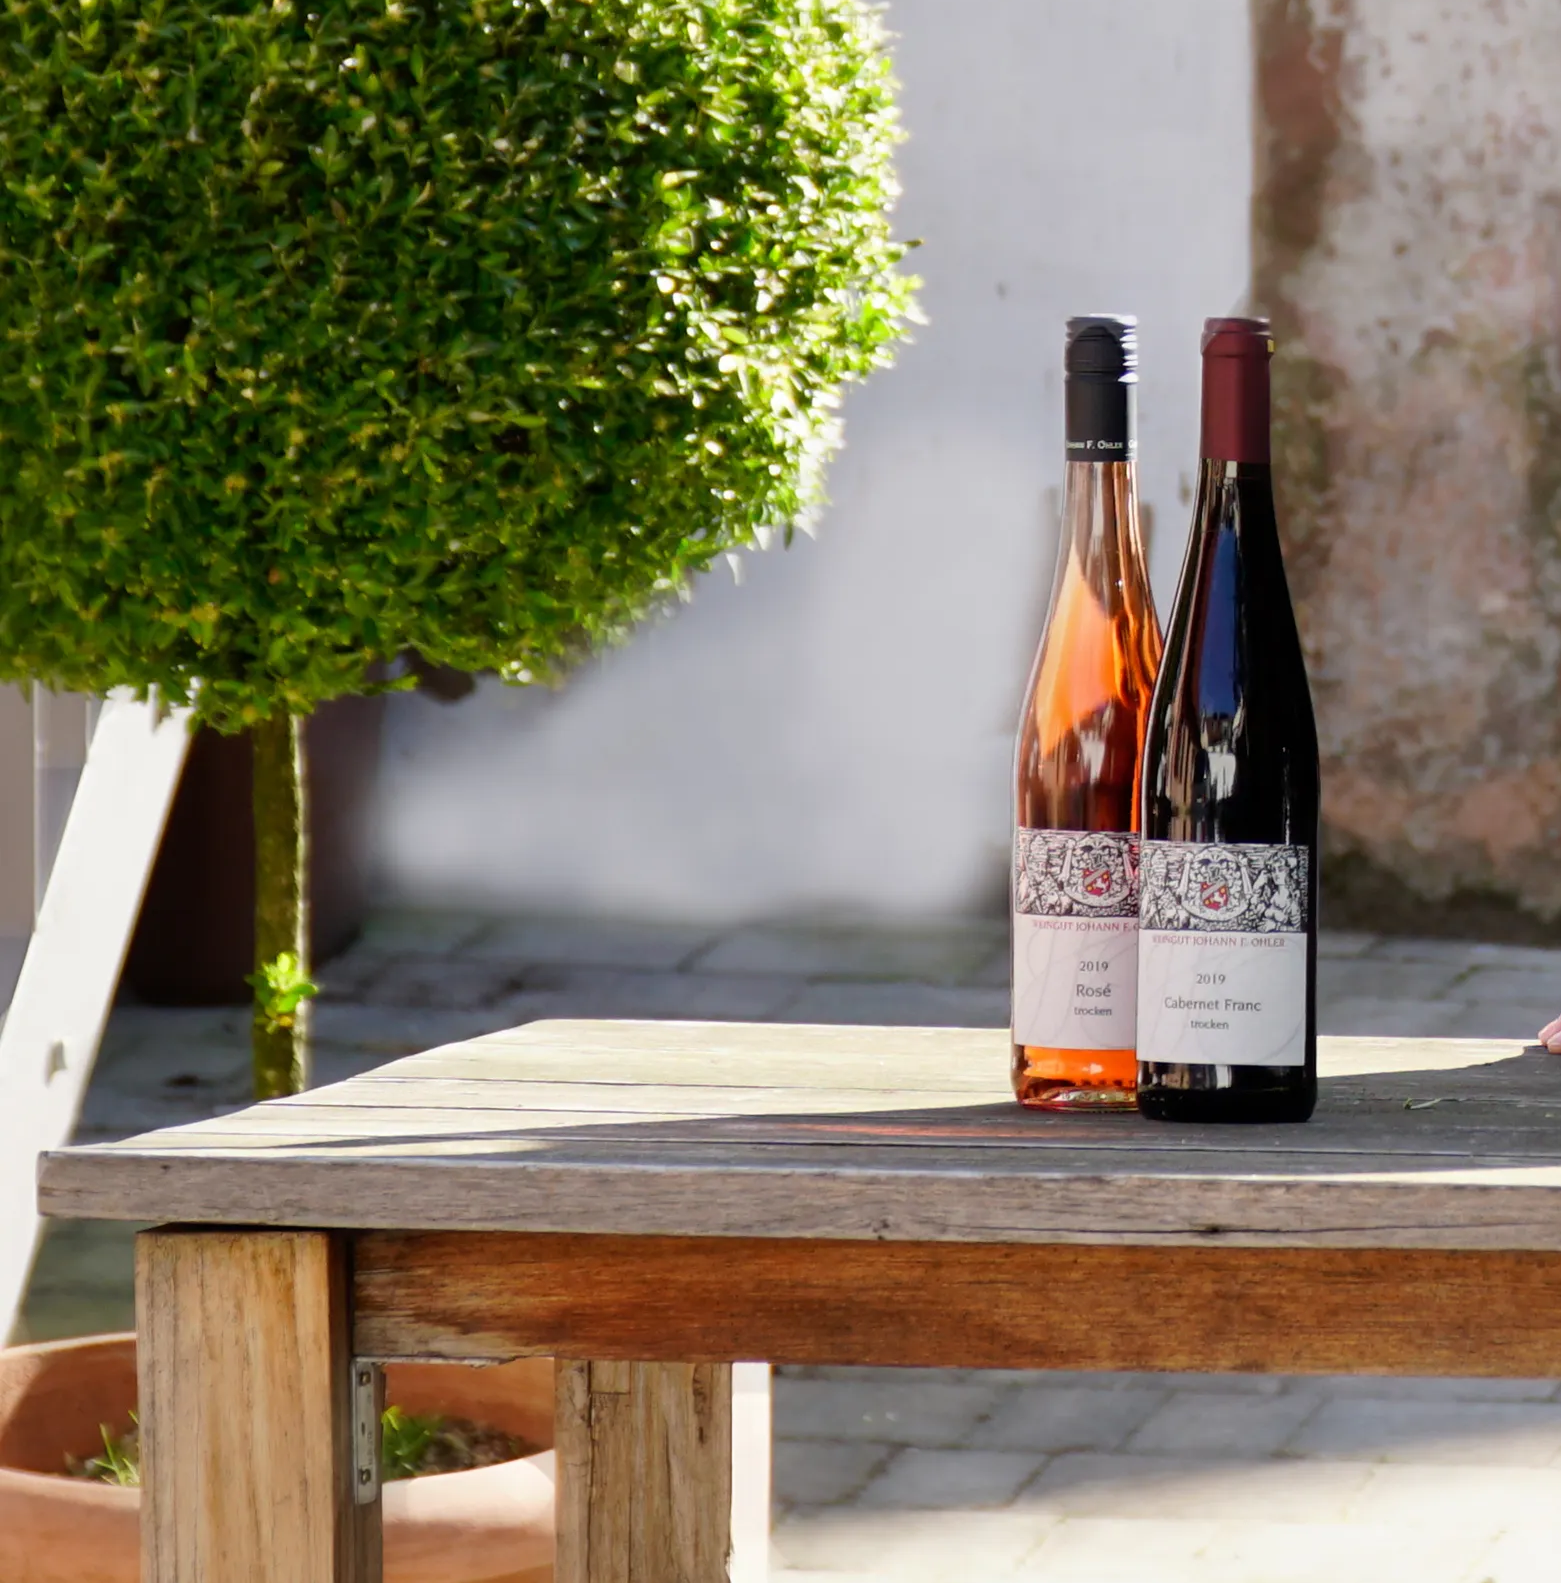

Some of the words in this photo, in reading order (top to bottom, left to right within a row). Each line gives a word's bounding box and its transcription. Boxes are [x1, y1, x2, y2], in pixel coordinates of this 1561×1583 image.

[1076, 921, 1119, 932] JOHANN
[1123, 923, 1132, 933] F.
[1193, 936, 1237, 946] JOHANN
[1250, 937, 1286, 948] OHLER
[1079, 960, 1109, 972] 2019
[1196, 973, 1227, 985] 2019
[1076, 982, 1112, 998] Rosé
[1164, 995, 1220, 1011] Cabernet
[1224, 998, 1262, 1012] Franc
[1073, 1006, 1113, 1017] trocken
[1190, 1019, 1230, 1030] trocken
